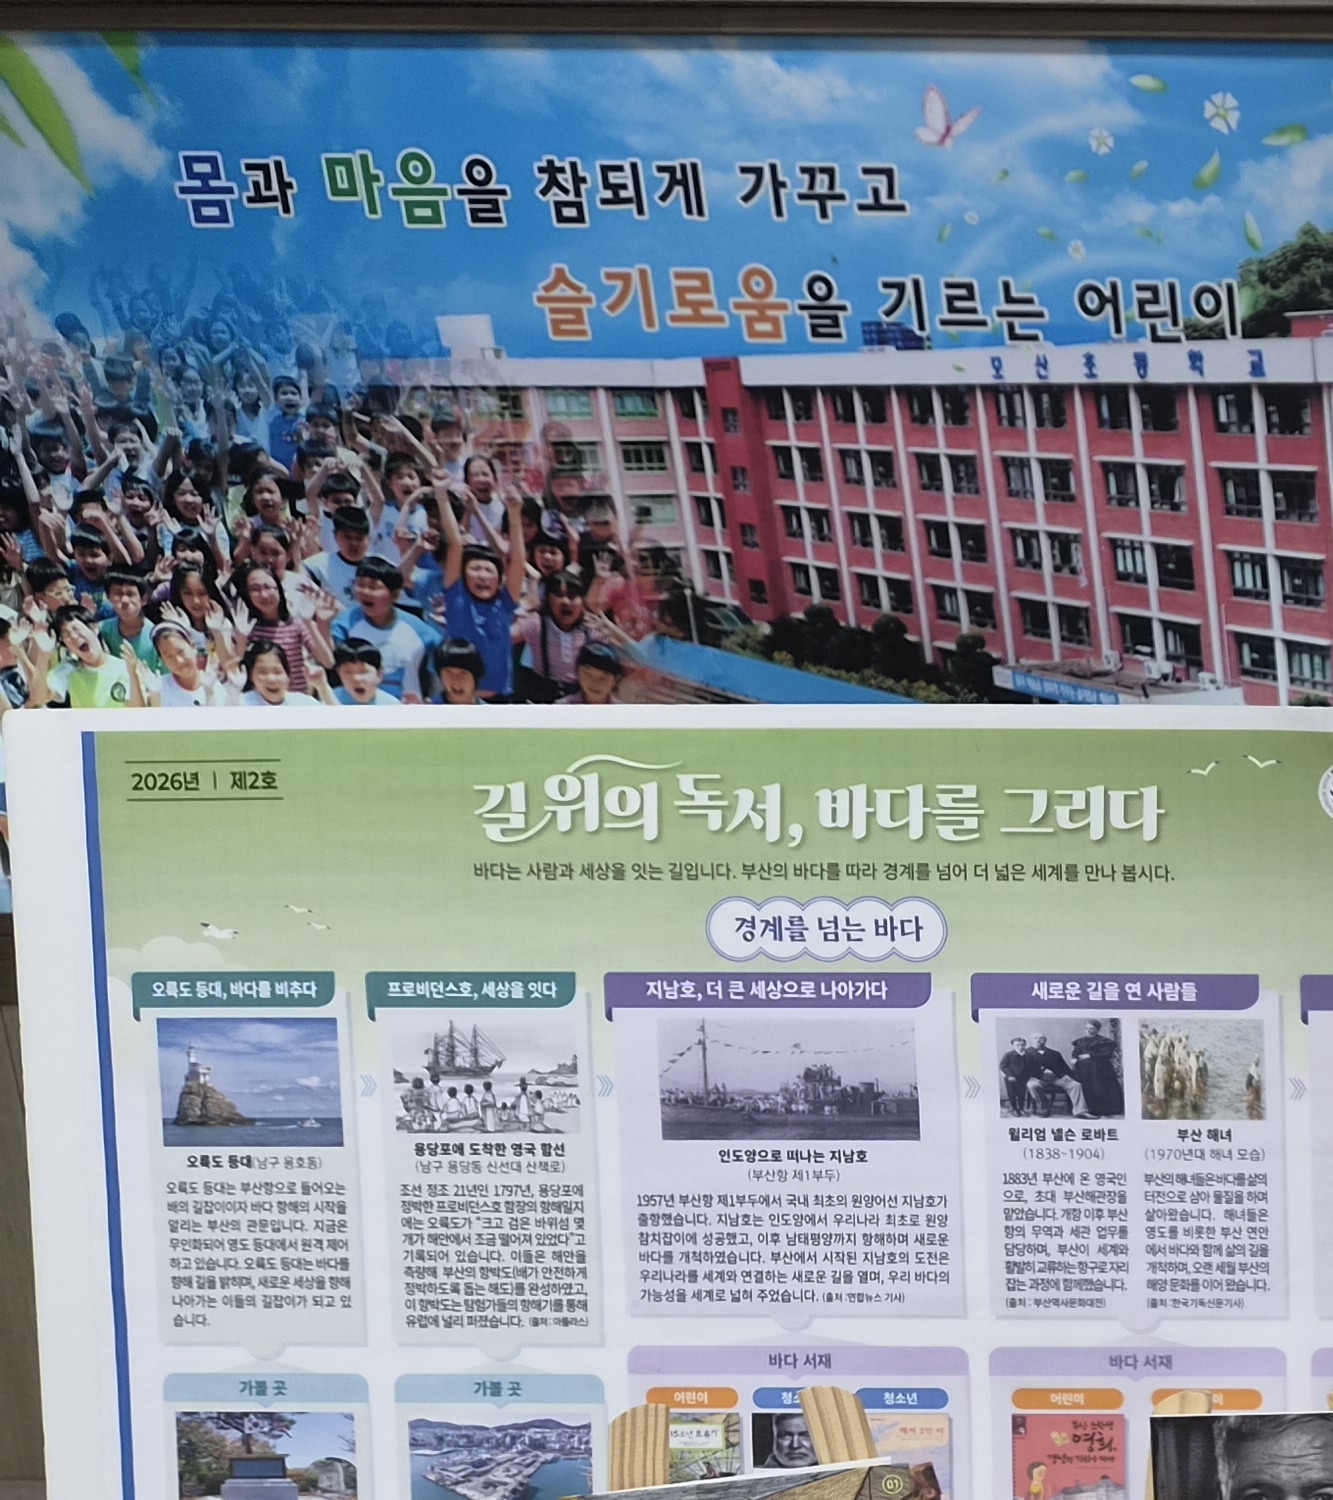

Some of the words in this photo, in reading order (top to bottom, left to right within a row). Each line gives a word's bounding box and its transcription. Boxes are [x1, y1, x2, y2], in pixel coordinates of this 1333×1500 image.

[176, 150, 296, 228] 몸과
[321, 147, 510, 228] 마음을
[535, 154, 708, 227] 참되게
[738, 160, 909, 221] 가꾸고
[533, 261, 850, 342] 슬기로움을
[879, 274, 1048, 345] 기르는
[1075, 277, 1243, 345] 어린이
[131, 771, 199, 790] 2026년
[231, 770, 278, 790] 제2호
[472, 781, 552, 842] 길
[544, 771, 658, 841] 위의
[674, 774, 803, 848] 독서,
[814, 783, 984, 841] 바다를
[1000, 784, 1165, 841] 그리다
[473, 862, 521, 880] 바다는
[526, 862, 573, 880] 사람과
[580, 862, 625, 880] 세상을
[631, 862, 662, 880] 잇는
[668, 862, 736, 880] 길입니다.
[741, 862, 788, 880] 부산의
[793, 862, 840, 880] 바다를
[846, 863, 877, 880] 따라
[883, 863, 930, 880] 경계를
[937, 863, 968, 881] 넘어
[974, 863, 989, 881] 더
[995, 864, 1026, 881] 넓은
[1031, 863, 1079, 881] 세계를
[1084, 864, 1116, 882] 만나
[1121, 864, 1174, 882] 봅시다.
[735, 916, 808, 942] 경계를
[818, 916, 865, 942] 넘는
[874, 916, 923, 942] 바다
[152, 981, 192, 998] 오륙도
[196, 981, 227, 999] 등대,
[230, 980, 271, 998] 바다를
[275, 980, 317, 998] 비추다
[387, 981, 478, 1000] 프로비던스호,
[481, 981, 524, 999] 세상을
[528, 981, 557, 998] 잇다
[646, 980, 702, 1000] 지남호,
[706, 981, 722, 998] 더
[728, 981, 744, 999] 큰
[750, 981, 816, 999] 세상으로
[821, 981, 887, 1000] 나아가다
[1031, 981, 1081, 1000] 새로운
[1086, 982, 1119, 1000] 길을
[1125, 982, 1141, 1000] 연
[1147, 981, 1197, 1001] 사람들
[1009, 1128, 1046, 1141] 윌리엄
[1052, 1128, 1075, 1141] 넬슨
[1081, 1128, 1118, 1141] 로바트
[1177, 1129, 1202, 1142] 부산
[1207, 1129, 1232, 1142] 해녀
[718, 1150, 782, 1163] 인도양으로
[787, 1150, 825, 1163] 떠나는
[830, 1150, 868, 1163] 지남호
[768, 1353, 798, 1369] 바다
[803, 1353, 831, 1369] 서재
[239, 1380, 267, 1396] 가볼
[272, 1380, 288, 1397] 곳
